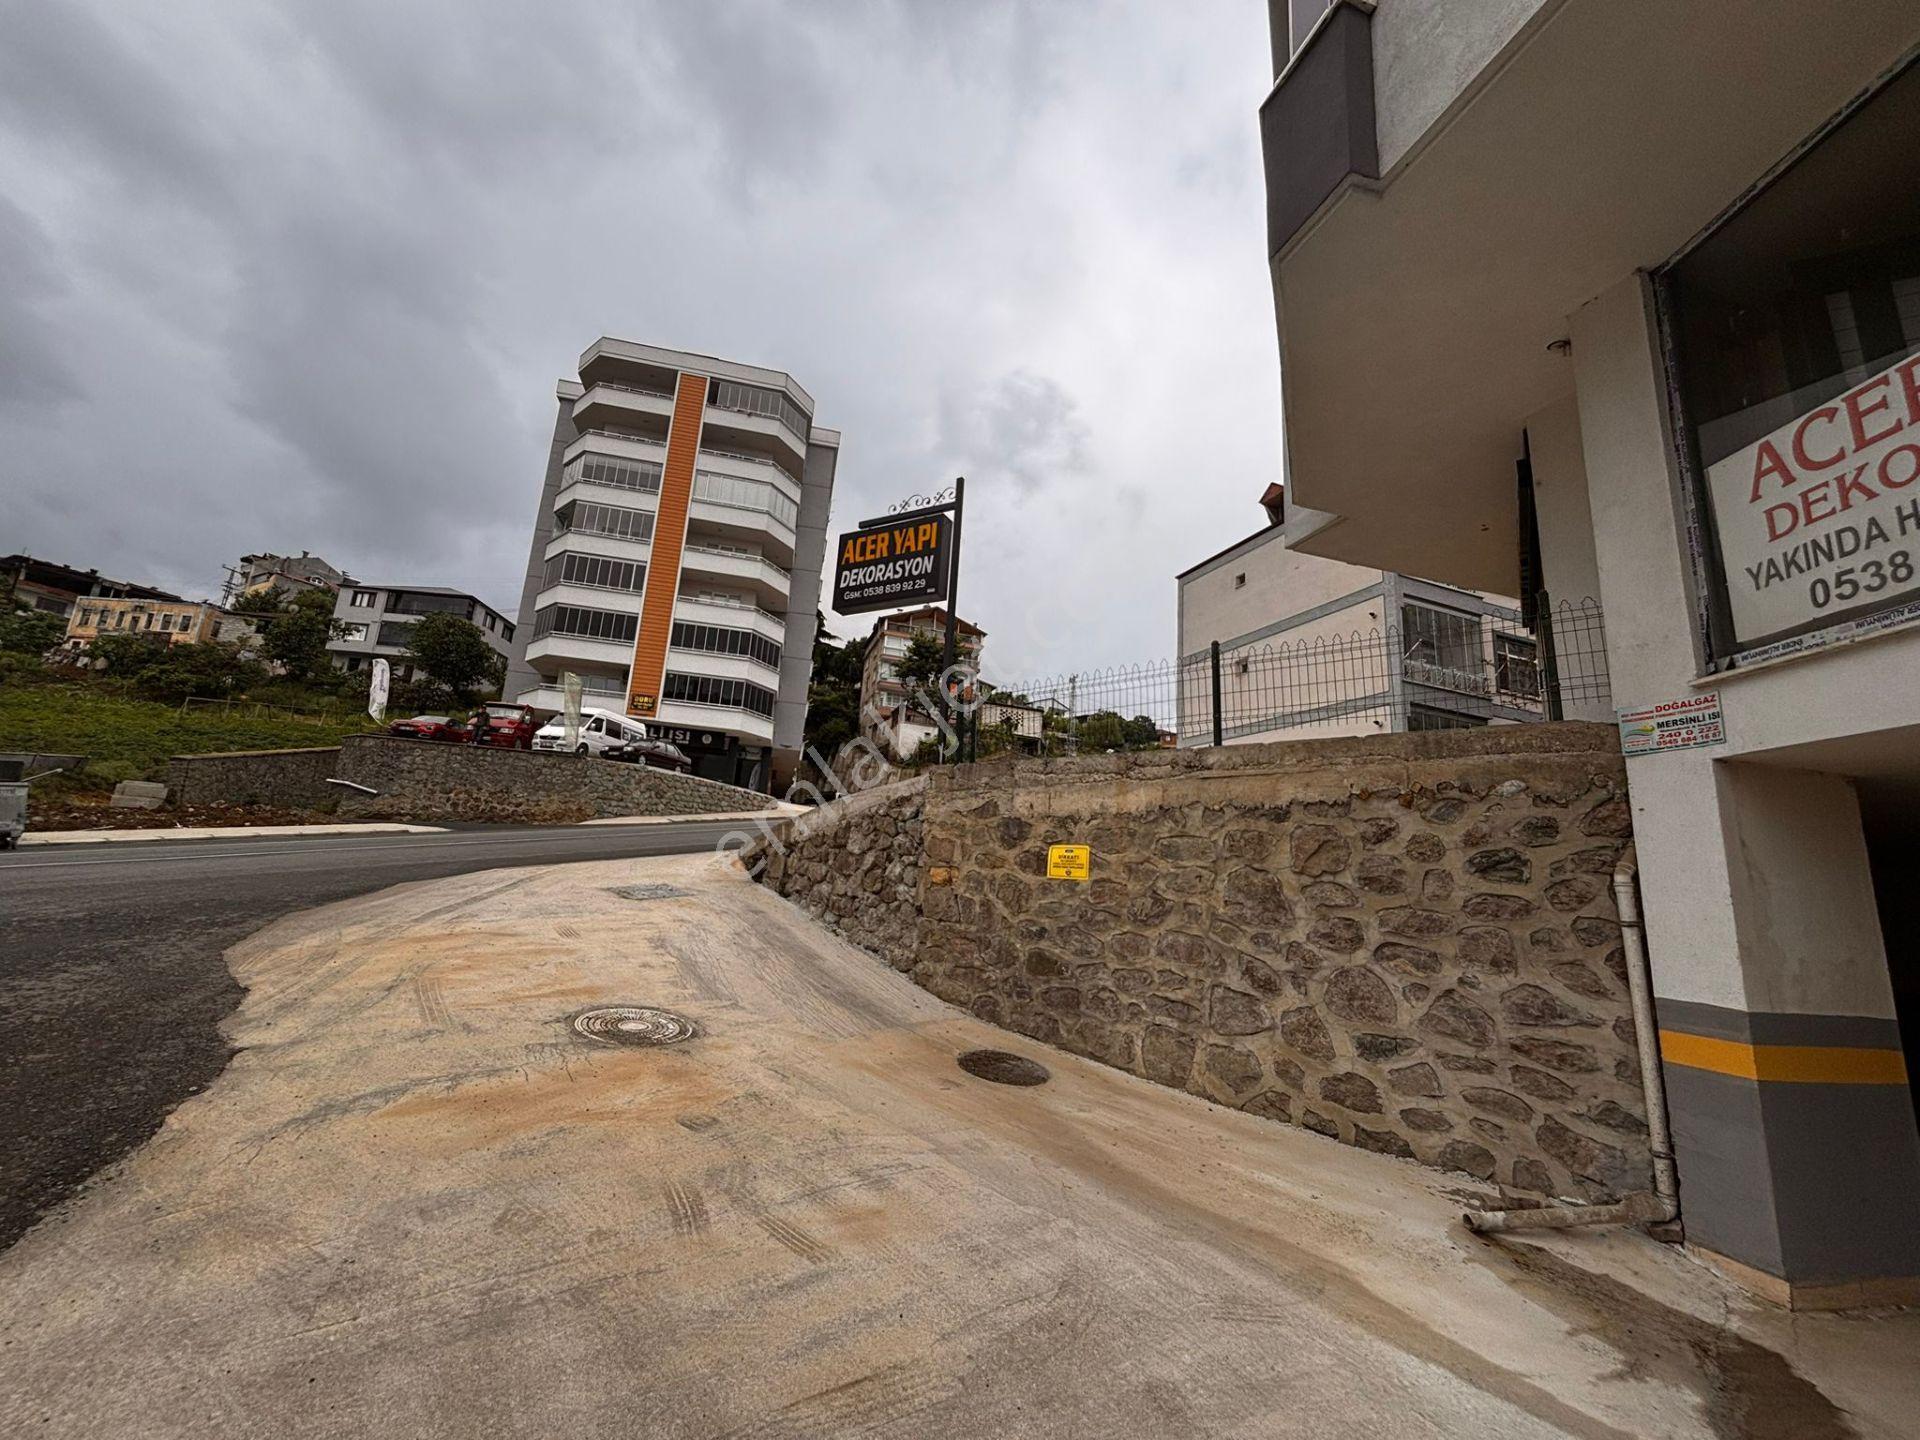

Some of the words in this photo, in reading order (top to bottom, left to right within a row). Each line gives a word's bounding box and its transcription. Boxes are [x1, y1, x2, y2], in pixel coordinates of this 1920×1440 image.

[841, 531, 889, 565] ACER
[893, 522, 938, 555] YAPI
[1745, 516, 1890, 592] YAKINDA
[840, 555, 934, 588] DEKORASYON
[863, 586, 883, 597] 0538
[885, 582, 901, 593] 839
[903, 581, 913, 590] 92
[914, 578, 926, 588] 29
[1809, 551, 1914, 608] 0538
[1655, 694, 1717, 713] DOĞALGAZ
[1656, 714, 1706, 729] MERSİNLİ
